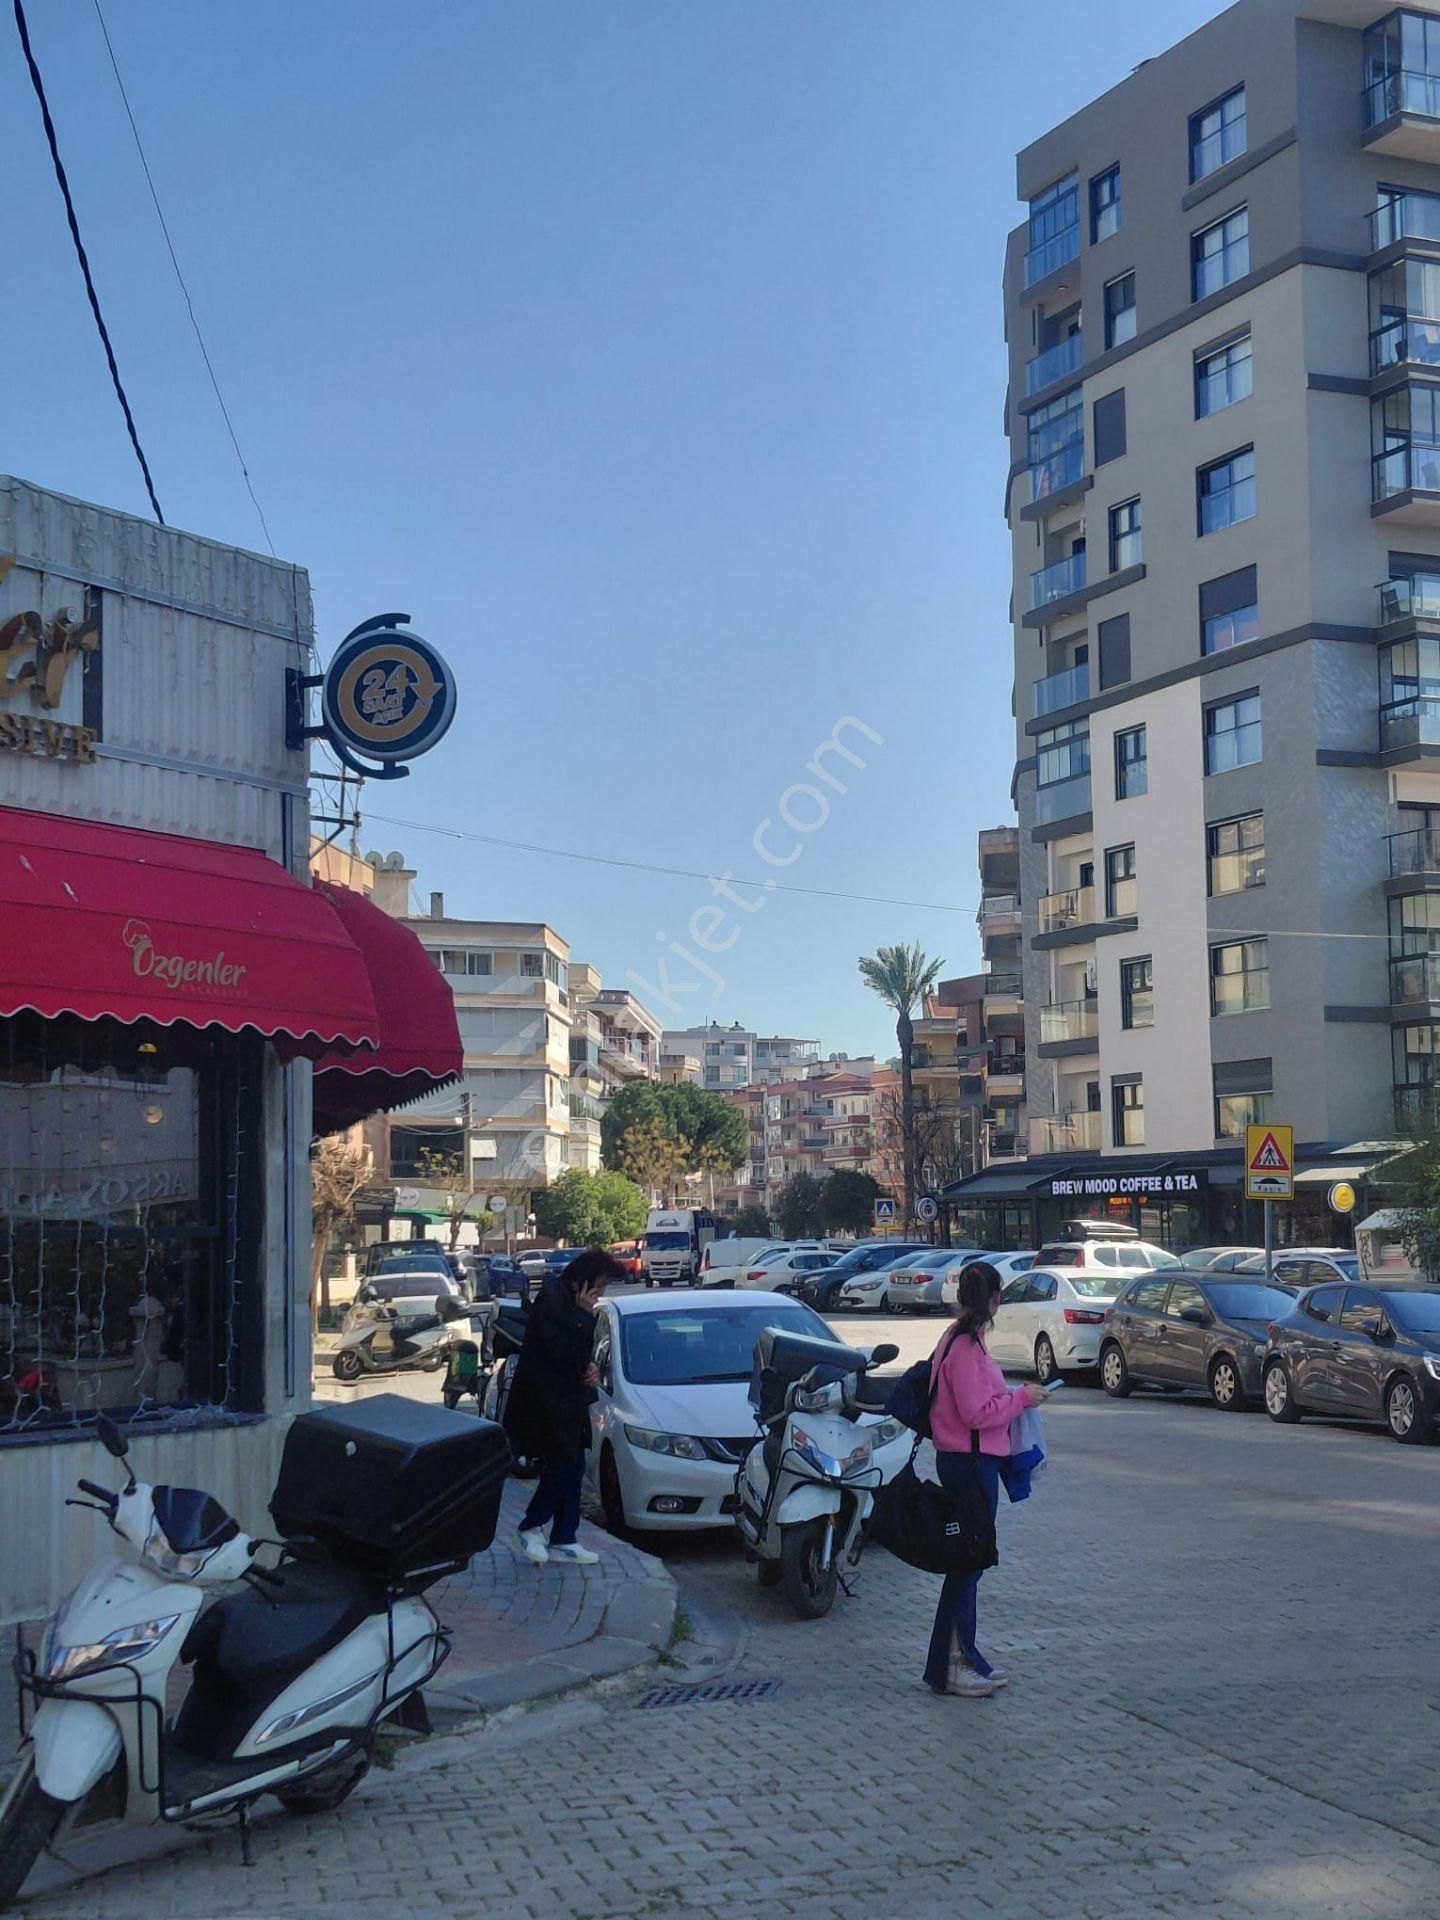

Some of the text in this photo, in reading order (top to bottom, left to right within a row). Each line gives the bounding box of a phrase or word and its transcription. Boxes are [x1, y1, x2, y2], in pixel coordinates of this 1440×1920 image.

[362, 664, 409, 700] 24
[1052, 1174, 1198, 1195] BREW MOOD COFFEE & TEA
